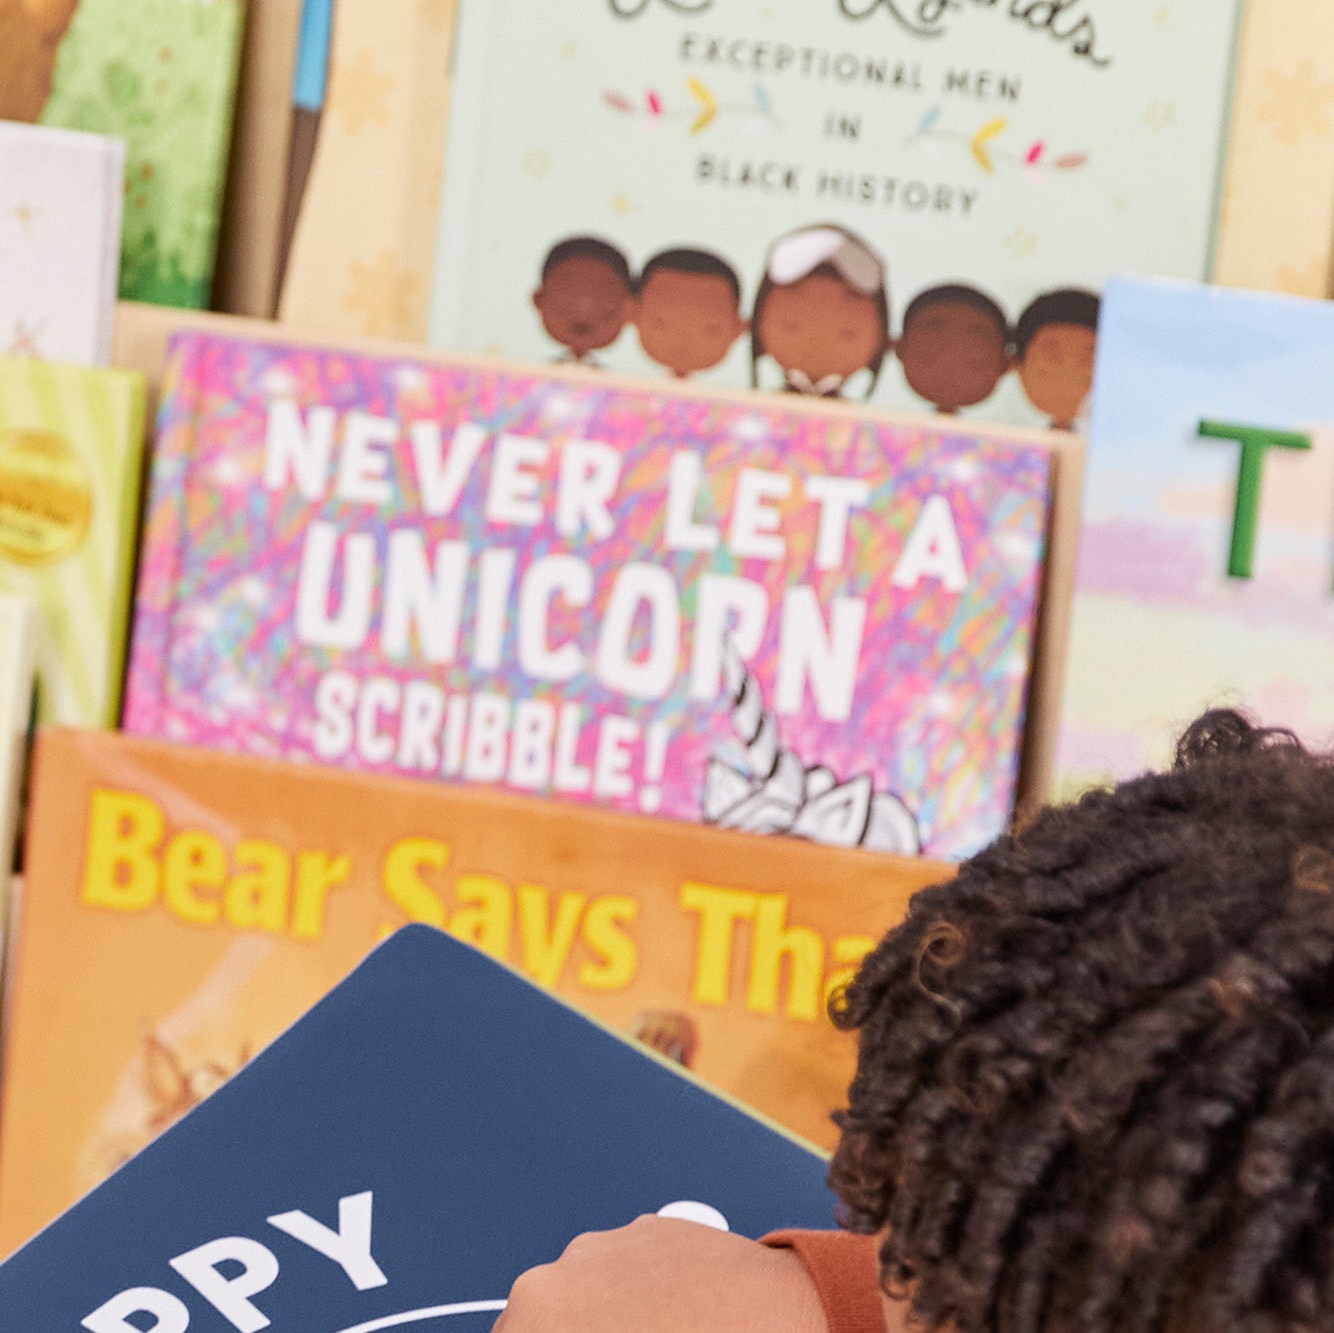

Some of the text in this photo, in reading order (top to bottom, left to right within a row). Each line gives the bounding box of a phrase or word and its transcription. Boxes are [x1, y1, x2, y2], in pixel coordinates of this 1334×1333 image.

[679, 32, 924, 92] EXCEPTIONAL
[944, 67, 1023, 102] MEN
[825, 112, 862, 141] IN
[697, 154, 980, 216] BLACK HISTORY
[264, 400, 969, 593] NEVER LET A
[294, 520, 867, 723] UNICORN
[311, 670, 666, 812] SCRIBBLE!
[82, 787, 350, 939] Bear
[377, 837, 639, 990] Says
